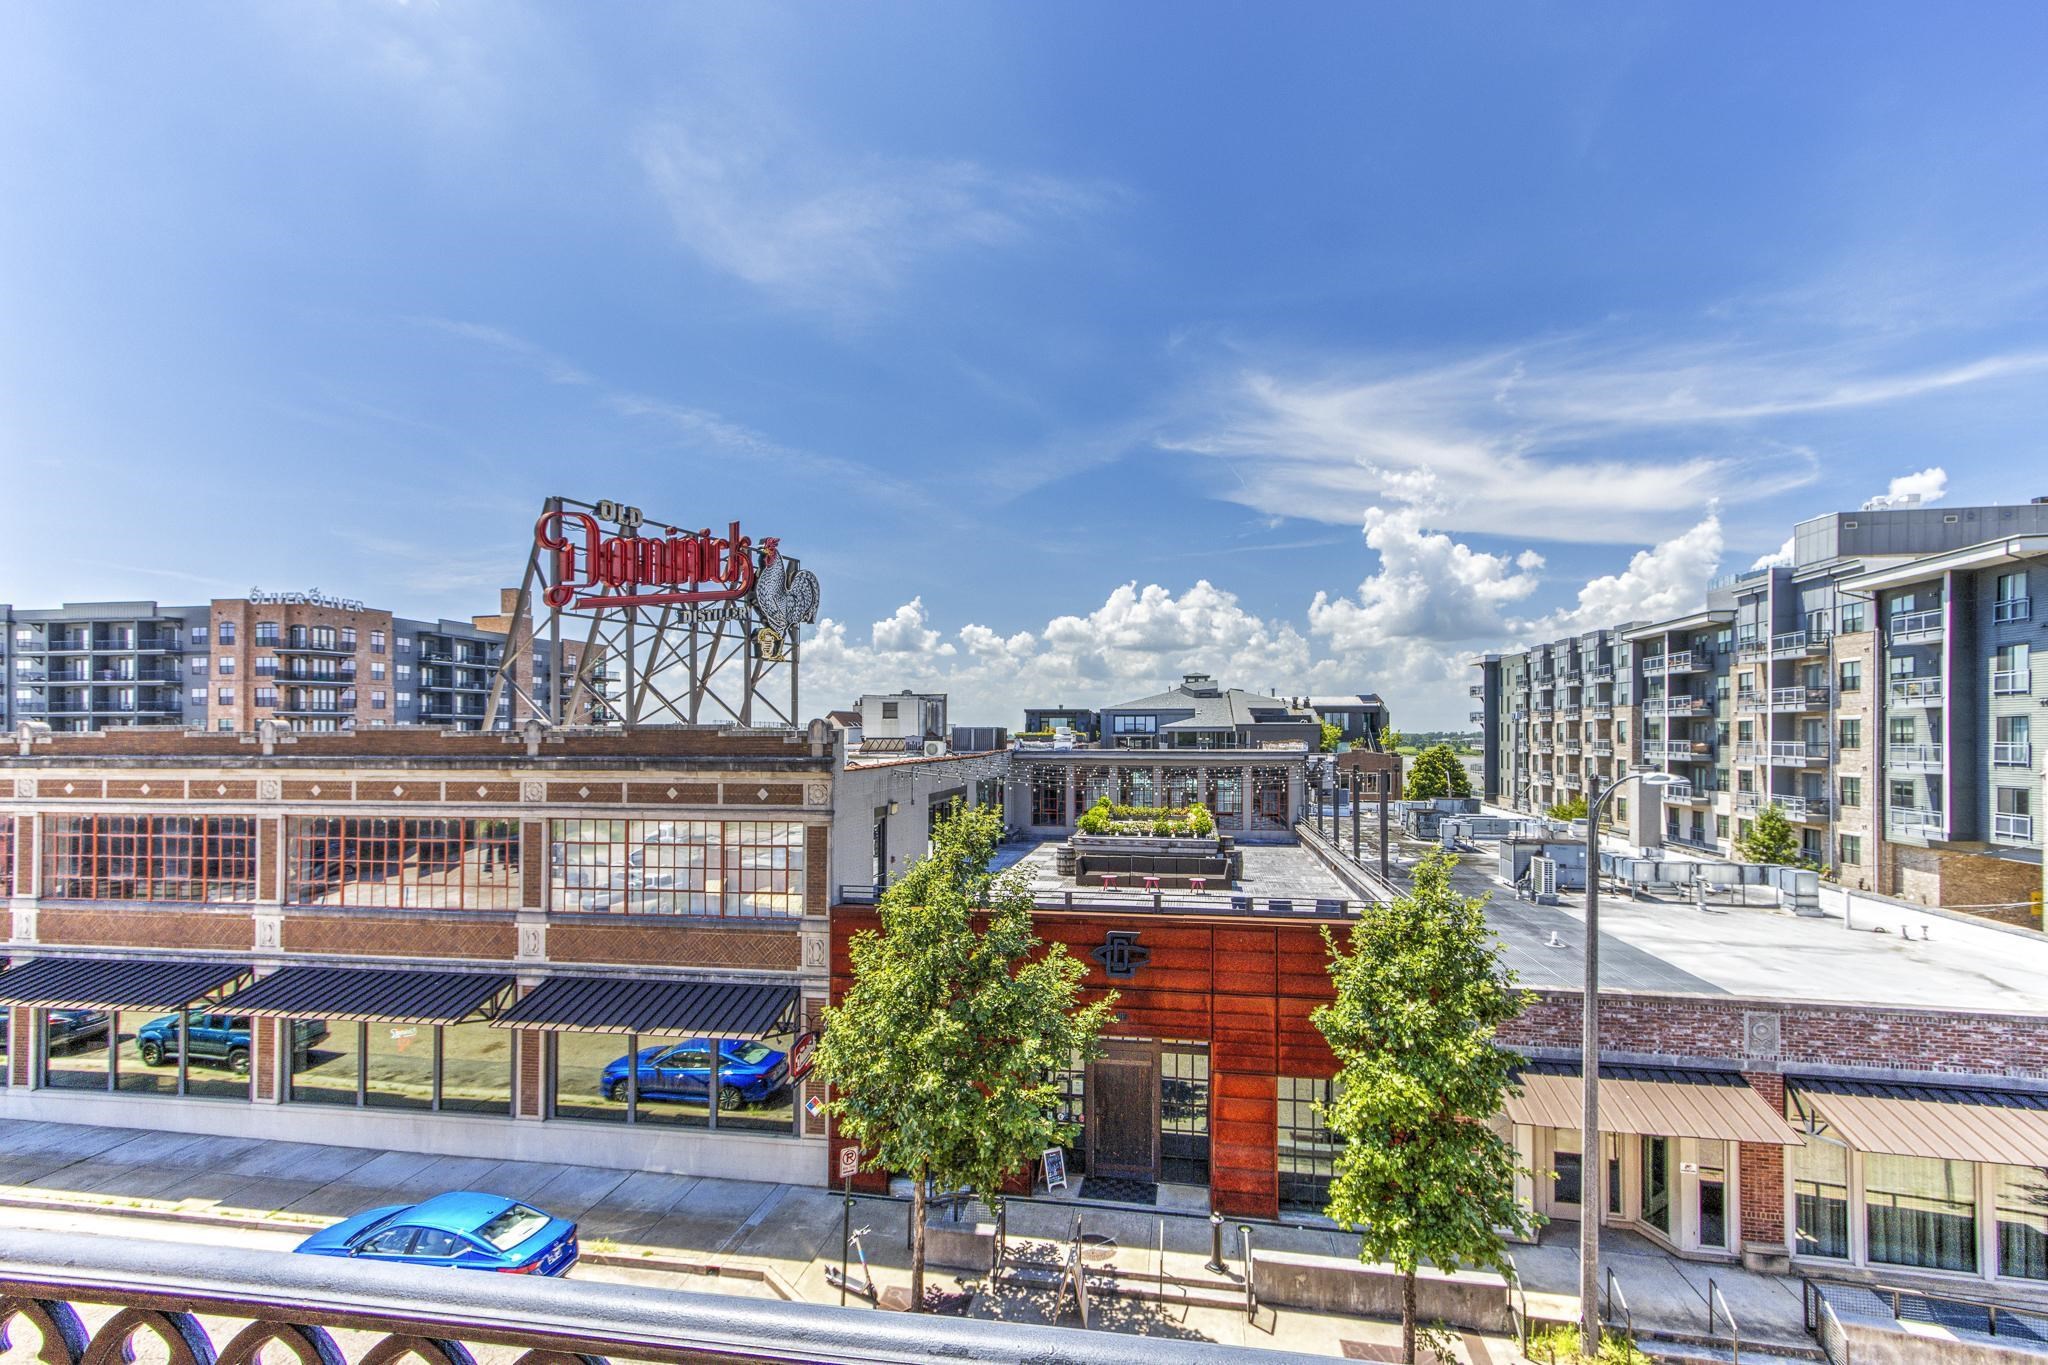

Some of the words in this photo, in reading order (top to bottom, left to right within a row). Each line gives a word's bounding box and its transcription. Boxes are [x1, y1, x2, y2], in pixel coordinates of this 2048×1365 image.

[597, 500, 644, 528] OLD
[249, 592, 305, 605] OLIVER
[310, 594, 364, 612] OLIVER
[680, 606, 753, 624] DISTILLERY
